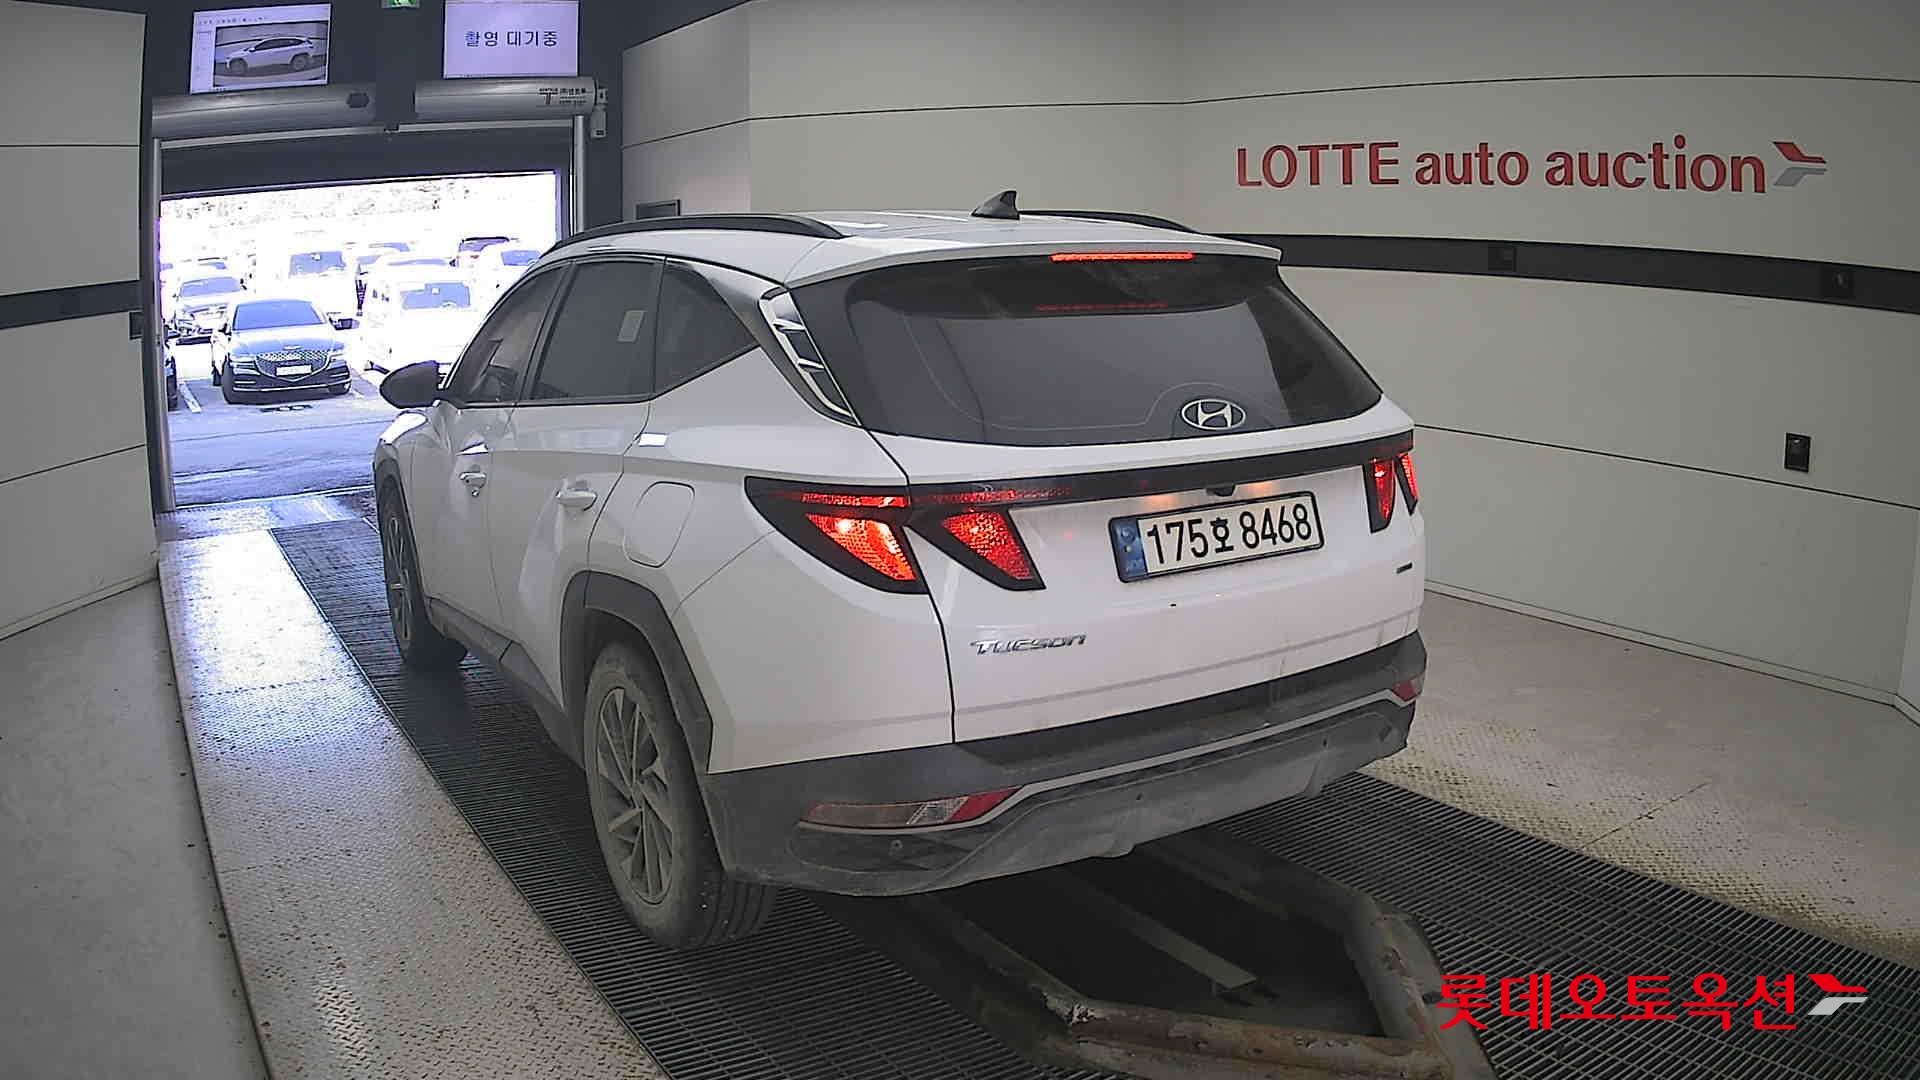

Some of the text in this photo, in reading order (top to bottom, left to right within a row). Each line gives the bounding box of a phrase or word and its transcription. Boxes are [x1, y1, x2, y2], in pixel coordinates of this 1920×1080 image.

[464, 30, 558, 48] 촬영 대기중
[1236, 134, 1767, 194] LOTTE auto auction
[1147, 503, 1312, 564] 175호 8468
